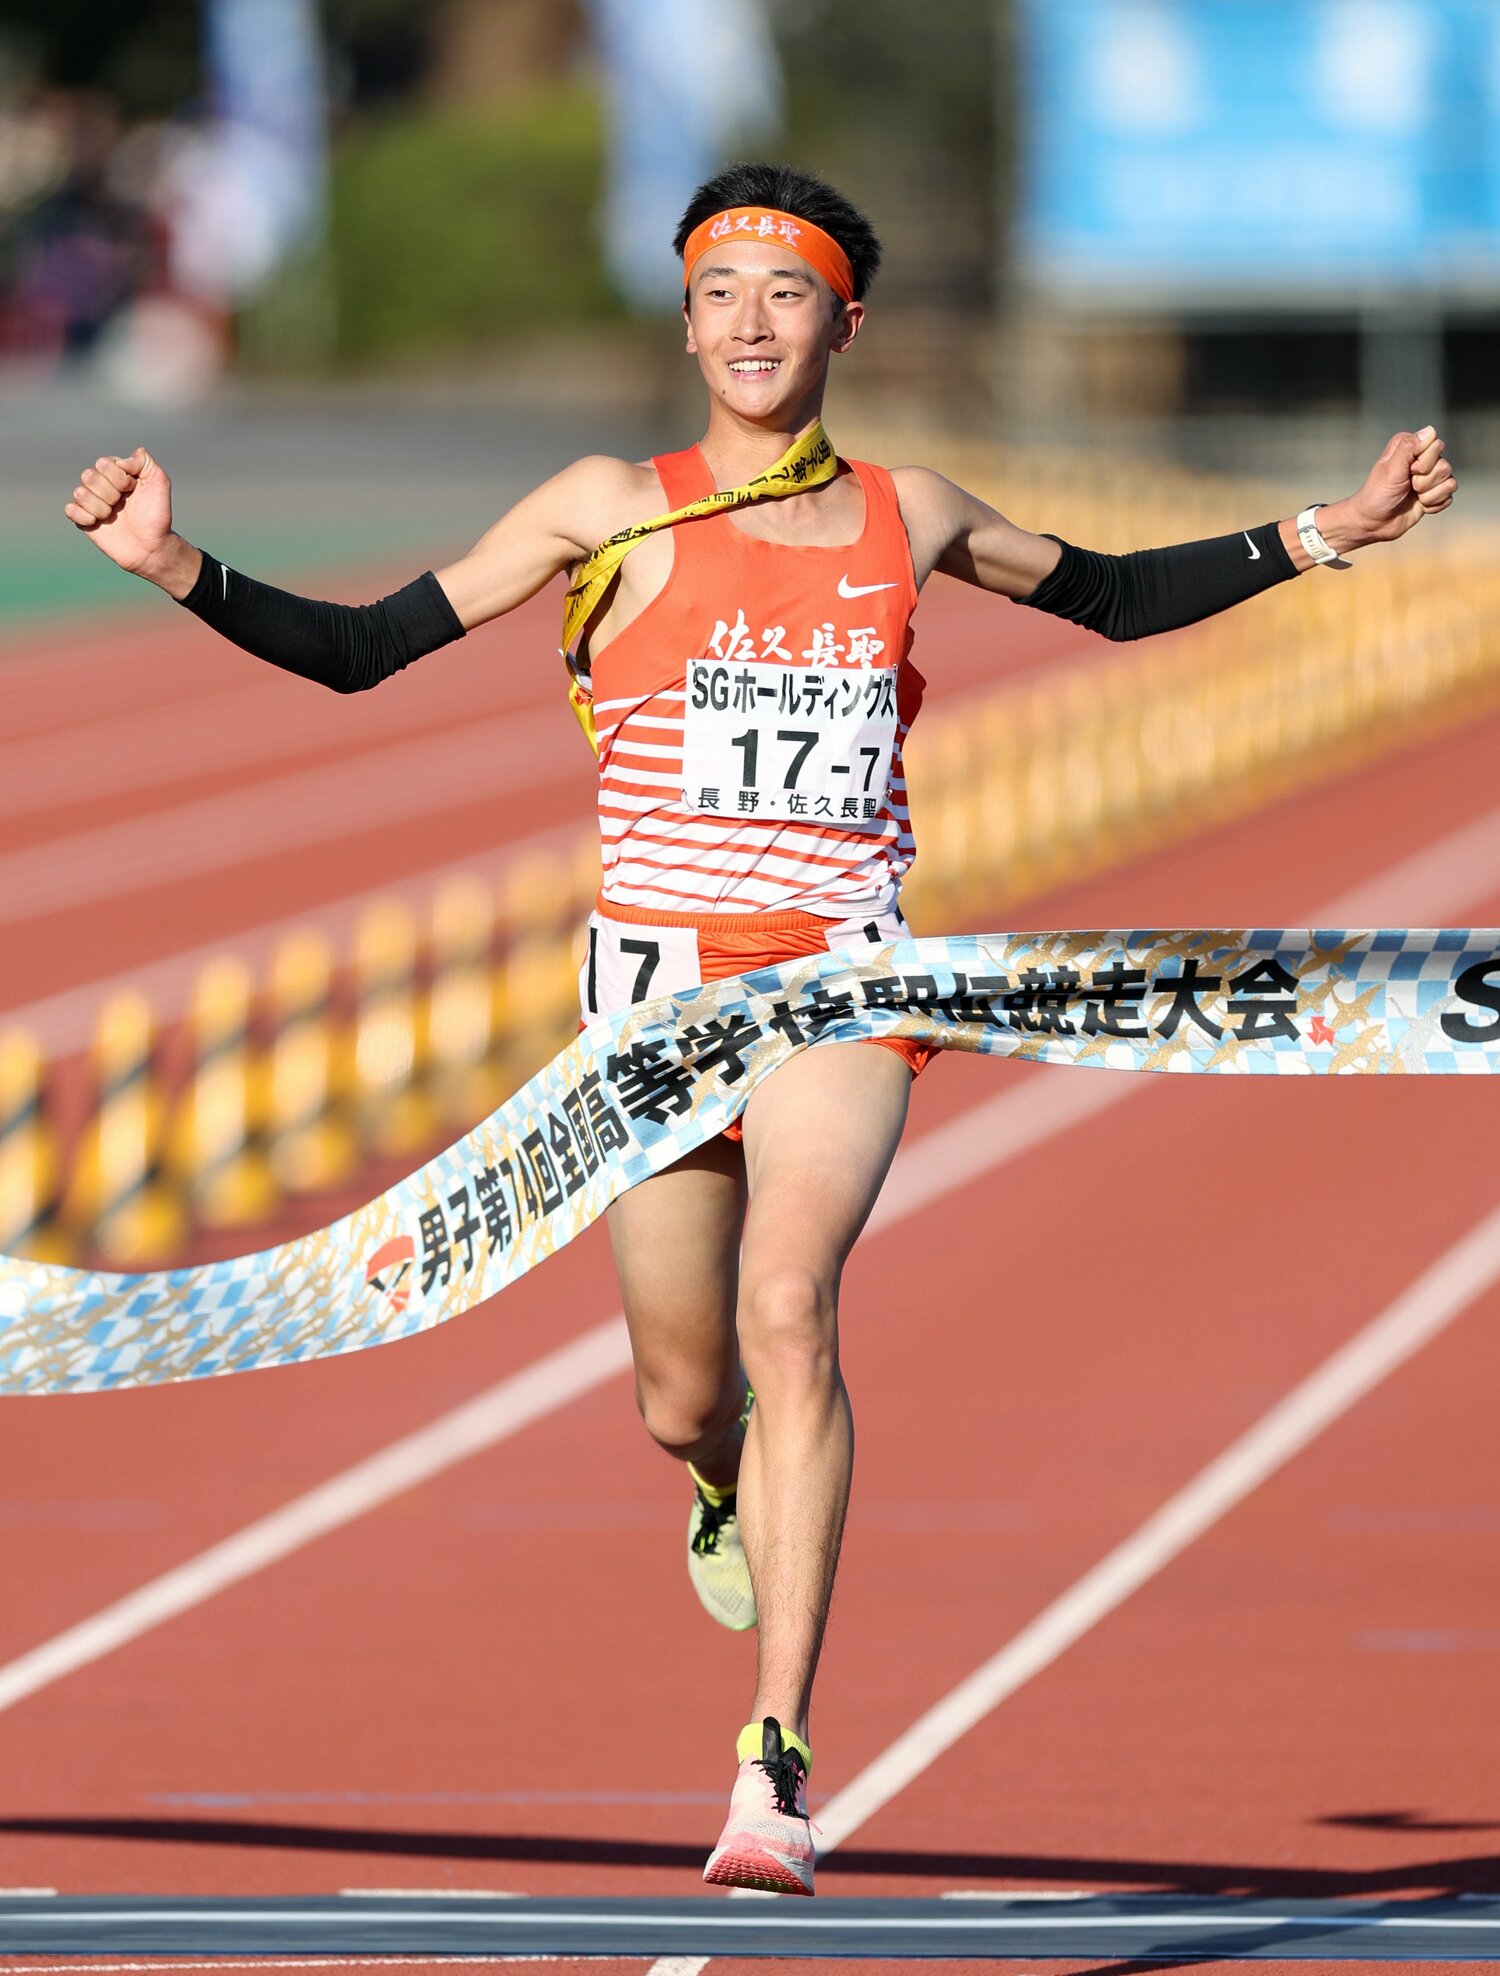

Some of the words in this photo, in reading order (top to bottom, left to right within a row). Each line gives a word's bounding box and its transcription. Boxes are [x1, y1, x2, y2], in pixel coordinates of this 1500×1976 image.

[709, 212, 804, 248] 佐久長聖
[708, 608, 885, 670] 佐久長聖
[691, 666, 894, 720] SGホールディングス
